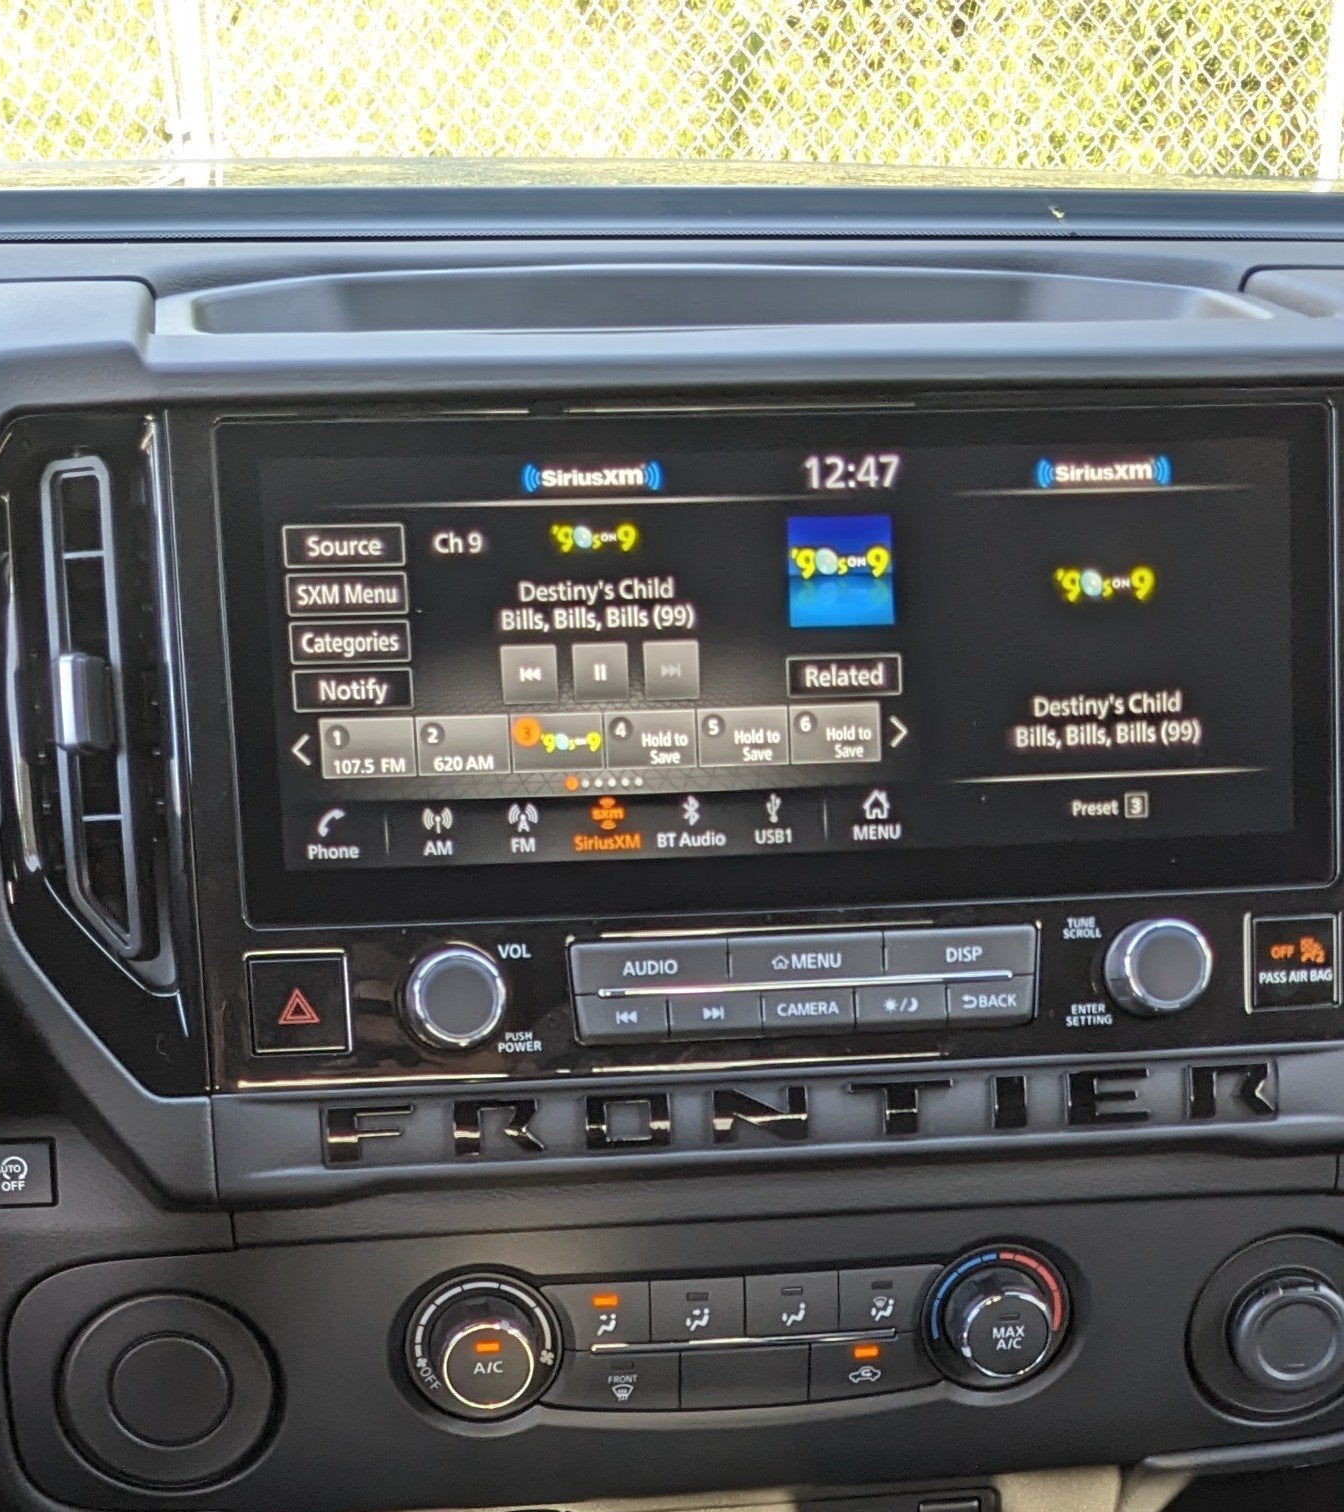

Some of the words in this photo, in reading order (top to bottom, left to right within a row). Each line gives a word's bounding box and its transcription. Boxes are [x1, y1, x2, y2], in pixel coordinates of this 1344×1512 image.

[805, 455, 899, 489] 12:47
[308, 536, 382, 557] Source
[434, 533, 463, 553] Ch
[469, 533, 482, 553] 9
[296, 584, 339, 606] SXM
[345, 583, 397, 604] Menu
[519, 580, 614, 605] Destiny's
[619, 577, 673, 599] Child
[501, 609, 549, 632] Bills,
[555, 607, 602, 631] Bills,
[607, 605, 649, 628] Bills
[654, 603, 695, 629] (99)
[302, 631, 399, 657] Categories
[806, 662, 884, 688] Related
[319, 678, 387, 704] Notify
[1033, 693, 1125, 720] Destiny's
[1129, 691, 1181, 714] Child
[615, 723, 626, 738] 4
[709, 720, 718, 735] 5
[800, 717, 810, 731] 6
[333, 730, 341, 746] 1
[428, 729, 438, 743] 2
[642, 733, 672, 747] Hold
[674, 732, 688, 746] to
[735, 730, 764, 744] Hold
[766, 730, 780, 744] to
[826, 727, 855, 742] Hold
[858, 727, 872, 740] to
[1015, 725, 1061, 749] Bills,
[1066, 723, 1111, 747] Bills,
[1116, 721, 1156, 744] Bills
[1161, 719, 1201, 745] (99)
[650, 751, 680, 764] Save
[743, 748, 772, 761] Save
[835, 744, 864, 759] Save
[334, 759, 375, 774] 107.5
[382, 758, 405, 773] FM
[434, 757, 462, 772] 620
[466, 756, 494, 771] AM
[1071, 800, 1119, 817] Preset
[1131, 798, 1142, 814] 3
[657, 833, 676, 848] BT
[680, 831, 726, 848] Audio
[755, 829, 792, 844] USB1
[854, 824, 901, 840] MENU
[424, 841, 452, 856] AM
[511, 838, 536, 852] FM
[573, 830, 642, 851] SiriusXM
[308, 844, 359, 860] Phone
[1067, 916, 1095, 929] TUNE
[1063, 928, 1102, 939] SCROLL
[498, 944, 531, 960] VOL
[945, 946, 983, 963] DISP
[1270, 944, 1294, 959] OFF
[622, 958, 678, 977] AUDIO
[791, 951, 842, 971] MENU
[1259, 971, 1287, 984] PASS
[1289, 970, 1307, 982] AIR
[1310, 970, 1333, 982] BAG
[978, 992, 1016, 1009] BACK
[777, 1001, 839, 1018] CAMERA
[1071, 1004, 1105, 1015] ENTER
[1066, 1014, 1113, 1027] SETTING
[505, 1032, 533, 1041] PUSH
[498, 1041, 542, 1052] POWER
[324, 1060, 1277, 1163] FRONTIER
[2, 1181, 25, 1191] OFF
[992, 1326, 1025, 1338] MAX
[997, 1337, 1022, 1350] A/C
[473, 1362, 503, 1375] A/C
[421, 1365, 441, 1390] OFF
[608, 1374, 637, 1384] FRONT
